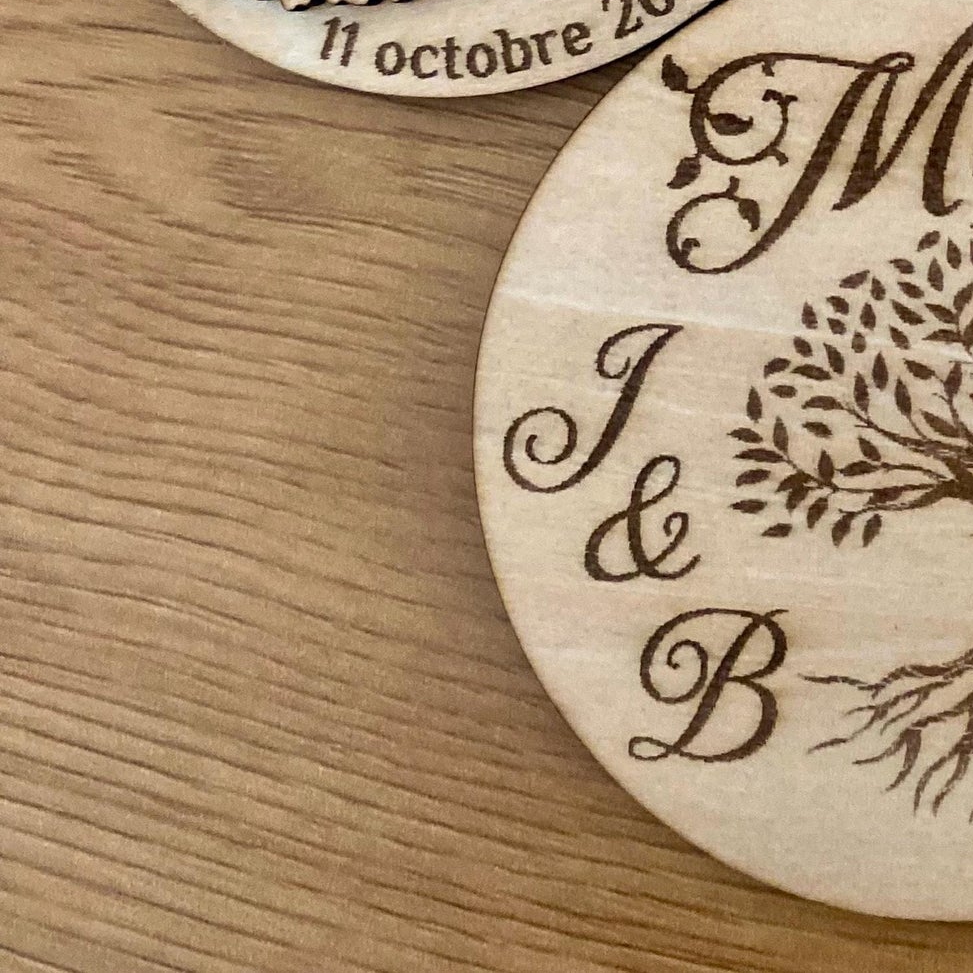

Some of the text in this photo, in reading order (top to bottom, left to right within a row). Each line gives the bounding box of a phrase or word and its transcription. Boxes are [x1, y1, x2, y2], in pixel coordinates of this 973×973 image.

[319, 15, 361, 68] 11
[374, 20, 594, 80] octobre
[583, 454, 701, 583] &
[627, 606, 791, 763] B
